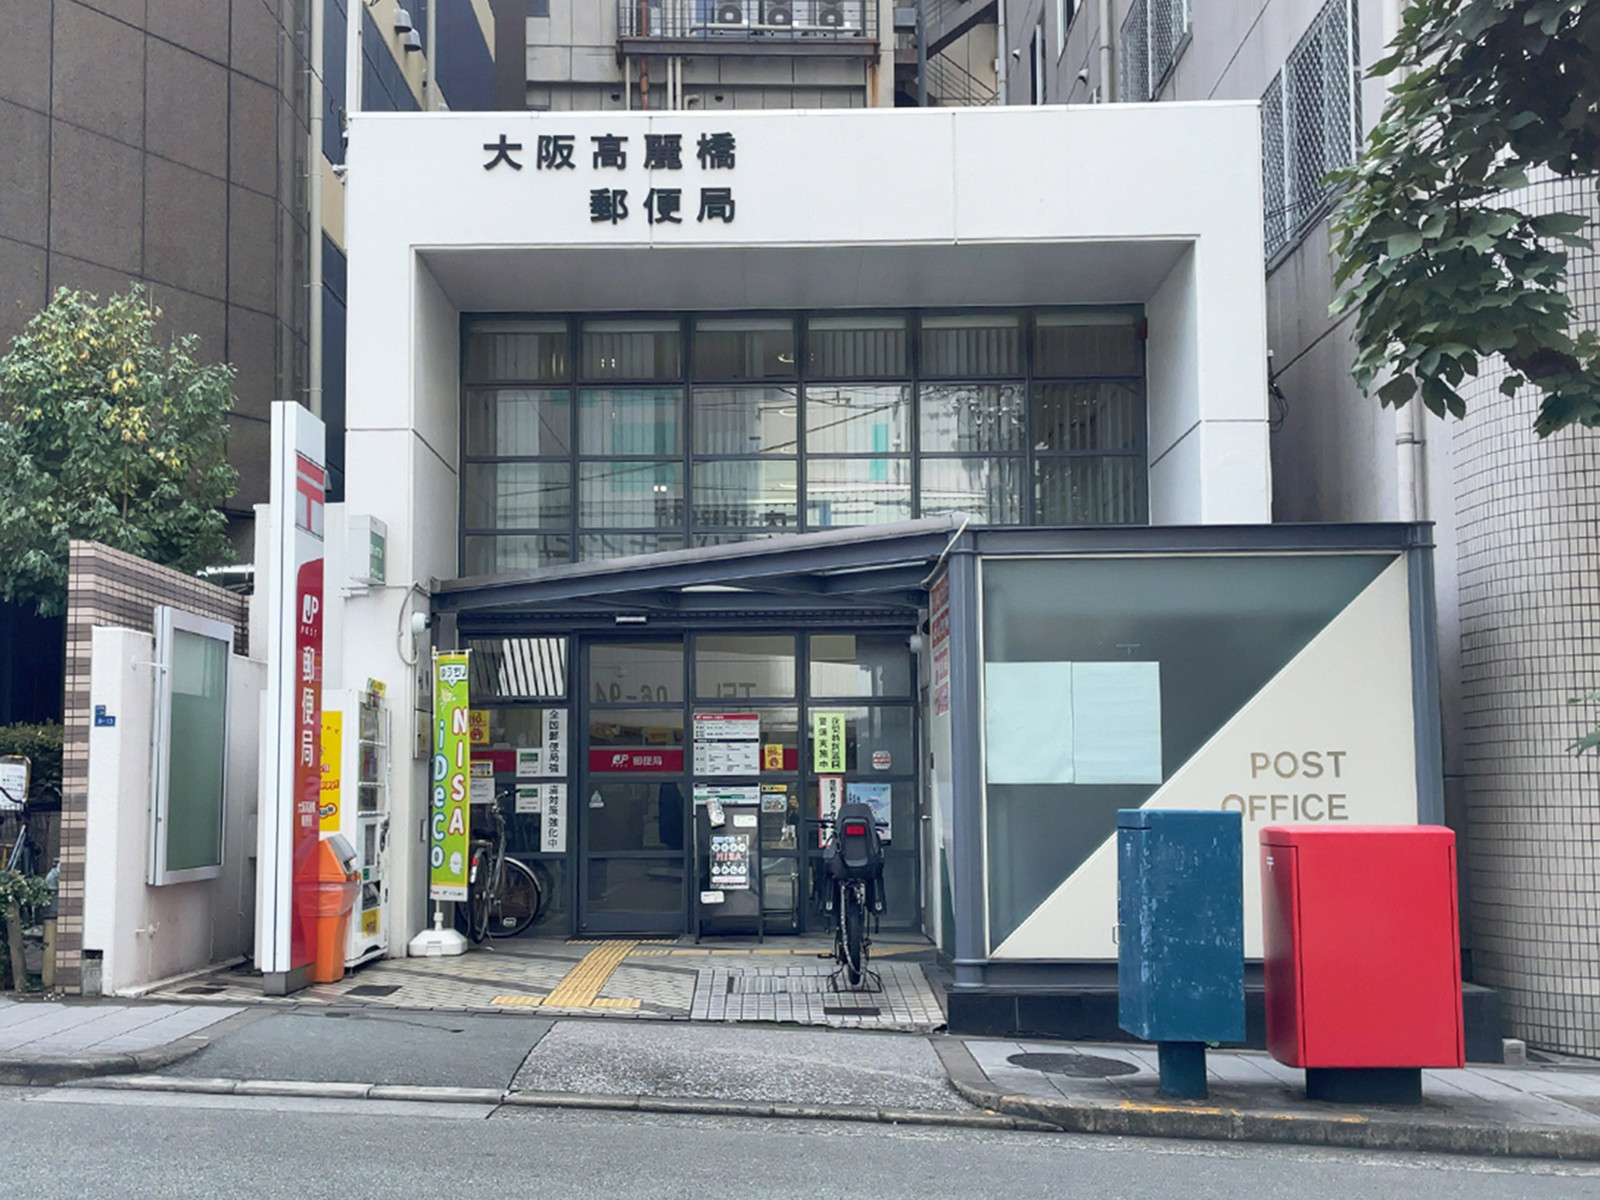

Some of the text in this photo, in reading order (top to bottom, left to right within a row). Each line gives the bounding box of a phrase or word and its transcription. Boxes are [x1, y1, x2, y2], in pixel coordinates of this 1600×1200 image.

[483, 132, 736, 171] 大阪高麗橋
[589, 187, 736, 225] 郵便局
[300, 645, 315, 768] 郵便局
[448, 705, 469, 836] NISA
[632, 755, 663, 766] 郵便局
[1250, 751, 1347, 779] POST
[431, 719, 449, 869] iDeCo
[1221, 793, 1349, 821] OFFICE
